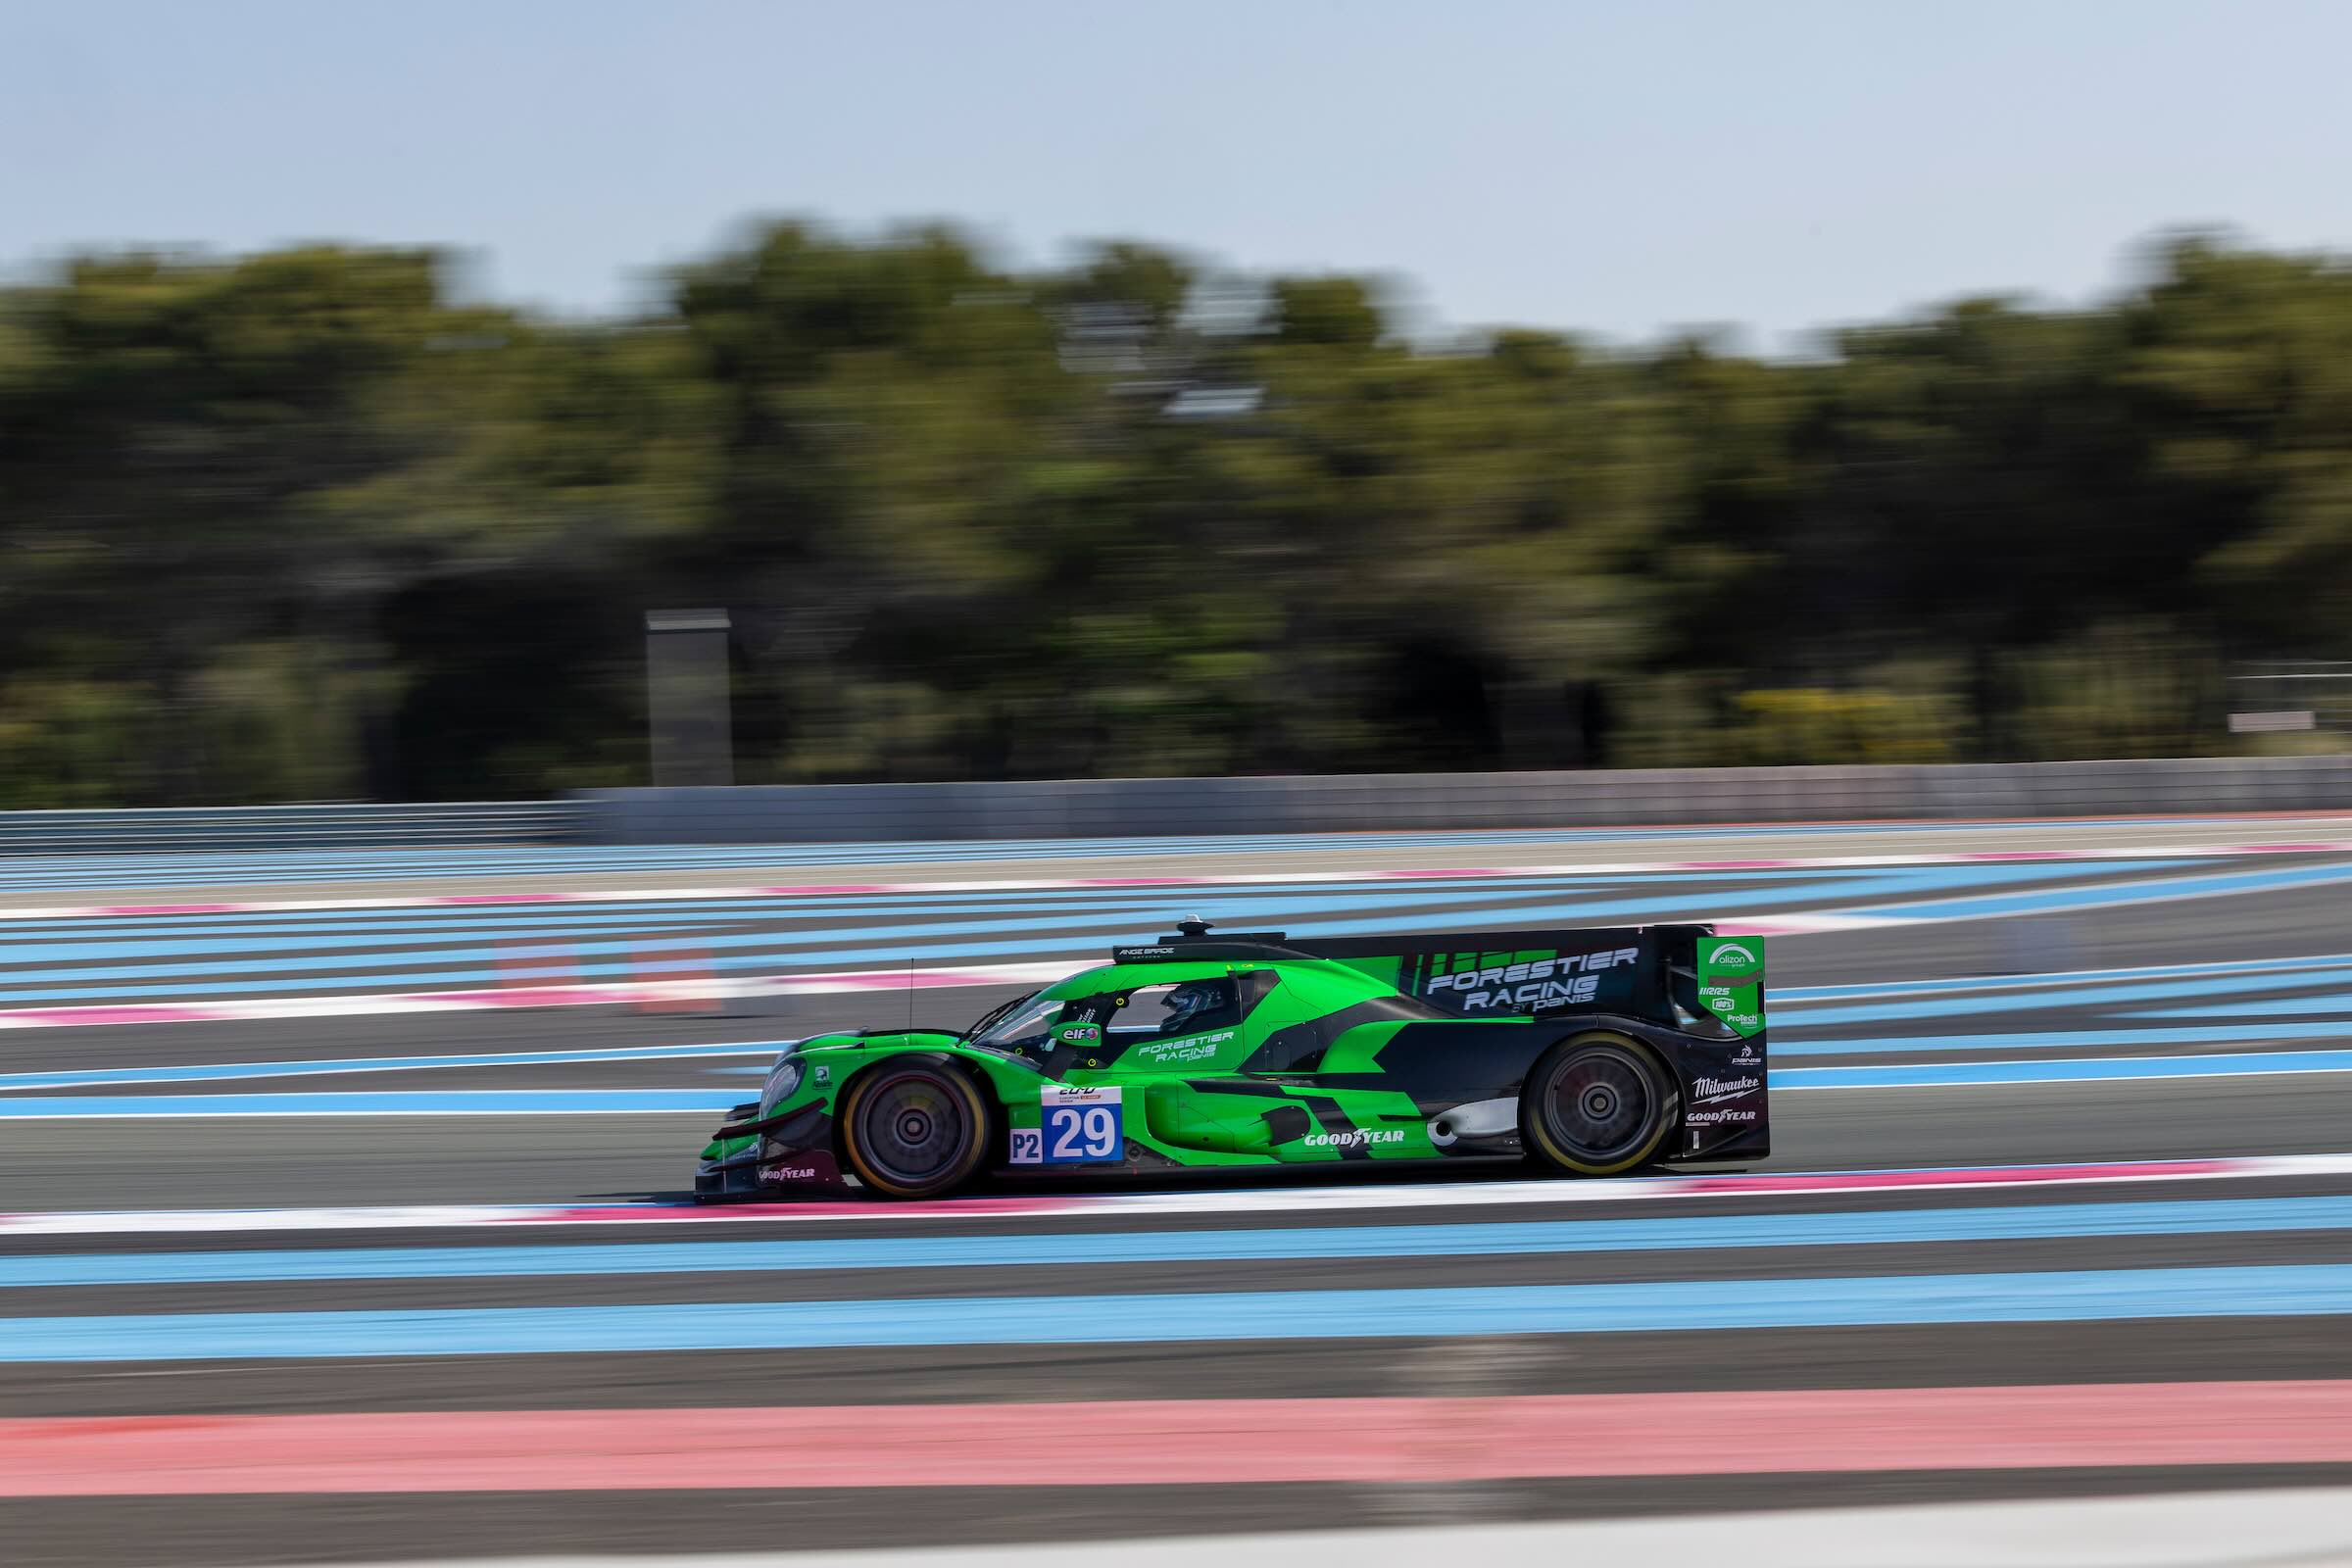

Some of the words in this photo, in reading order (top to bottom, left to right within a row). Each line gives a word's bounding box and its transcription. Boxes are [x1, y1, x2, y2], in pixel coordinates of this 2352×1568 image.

[1427, 947, 1640, 996] FORESTIER
[1463, 974, 1600, 1011] RACING
[1727, 1013, 1758, 1022] ProTech
[1063, 1029, 1086, 1040] elf
[1138, 1031, 1235, 1056] FORESTIER
[1155, 1044, 1217, 1062] RACING
[1691, 1076, 1760, 1098] Milwaukee
[1687, 1109, 1756, 1123] GOODYEAR
[1052, 1107, 1116, 1157] 29
[1304, 1128, 1404, 1148] GOODYEAR
[1012, 1133, 1040, 1159] P2
